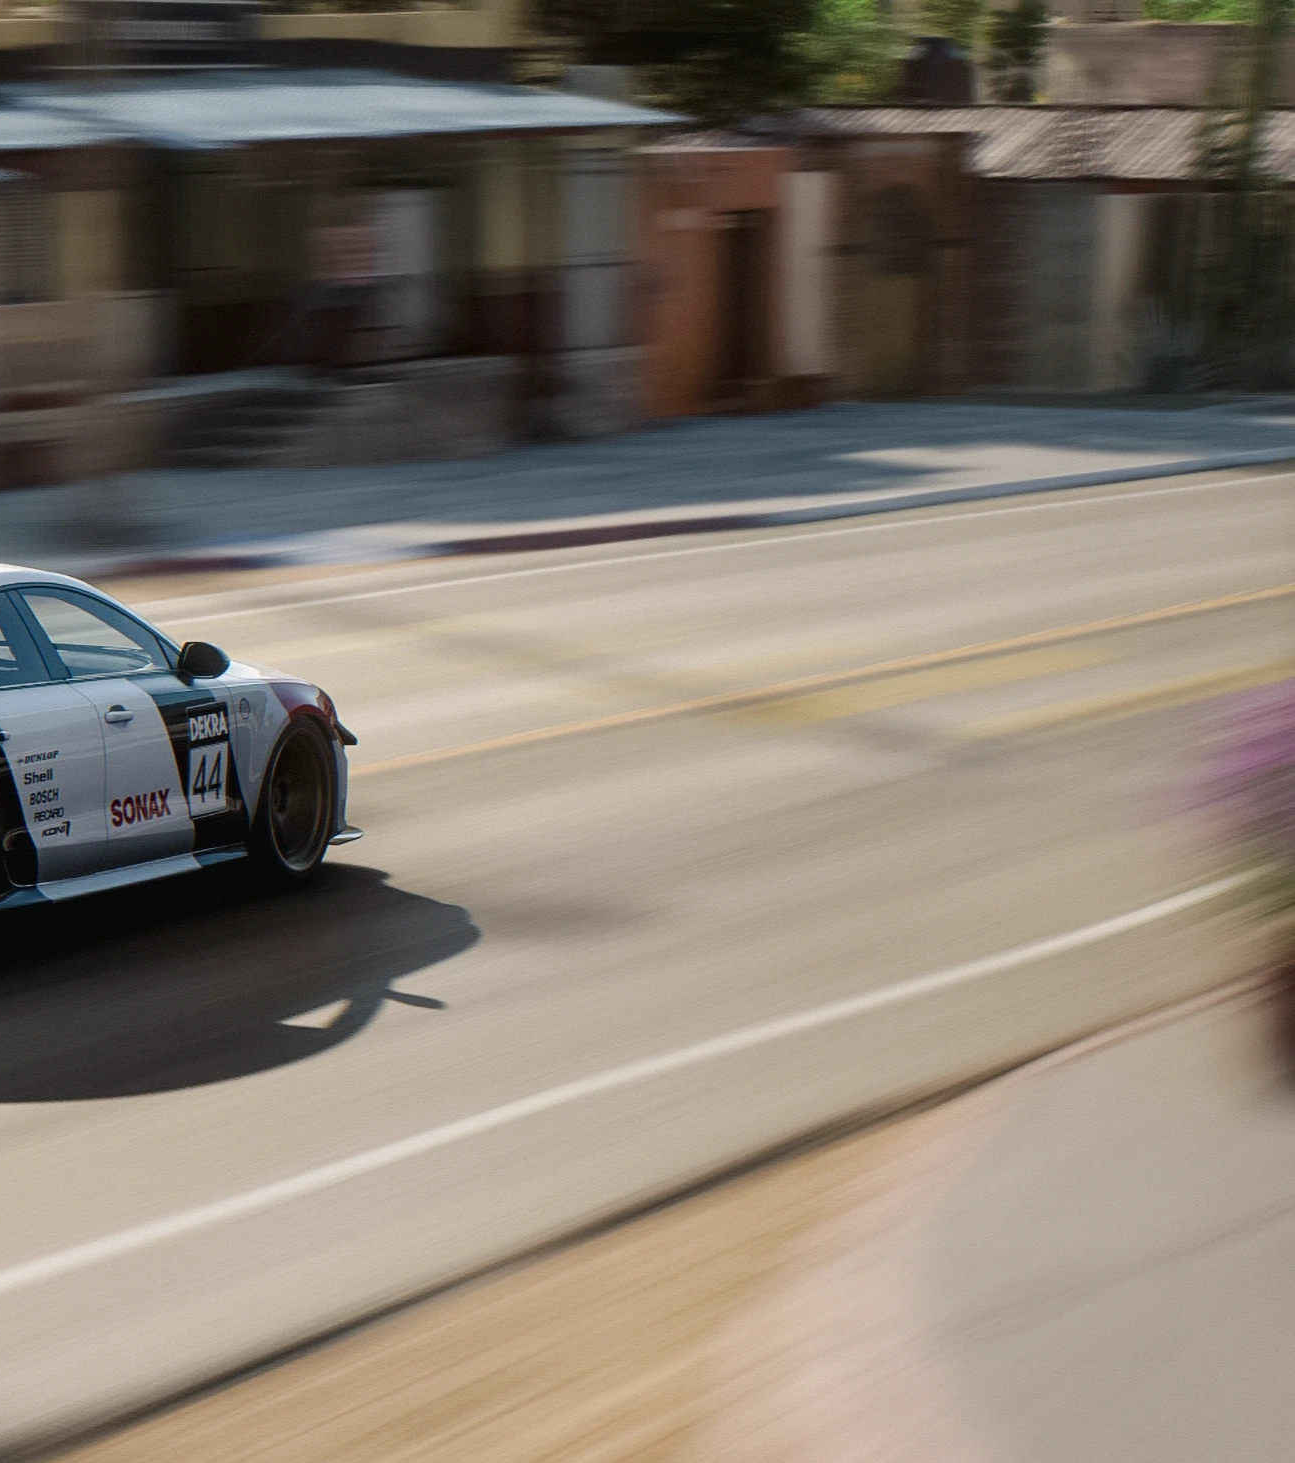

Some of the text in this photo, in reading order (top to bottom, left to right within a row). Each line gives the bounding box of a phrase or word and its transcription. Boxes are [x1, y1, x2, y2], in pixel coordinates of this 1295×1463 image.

[189, 711, 228, 742] DEKRA
[24, 750, 59, 764] DUNLOP
[24, 768, 53, 785] Shell
[192, 750, 222, 803] 44
[29, 788, 59, 806] BOSCH
[33, 807, 65, 823] RECARO
[110, 788, 171, 828] SONAX
